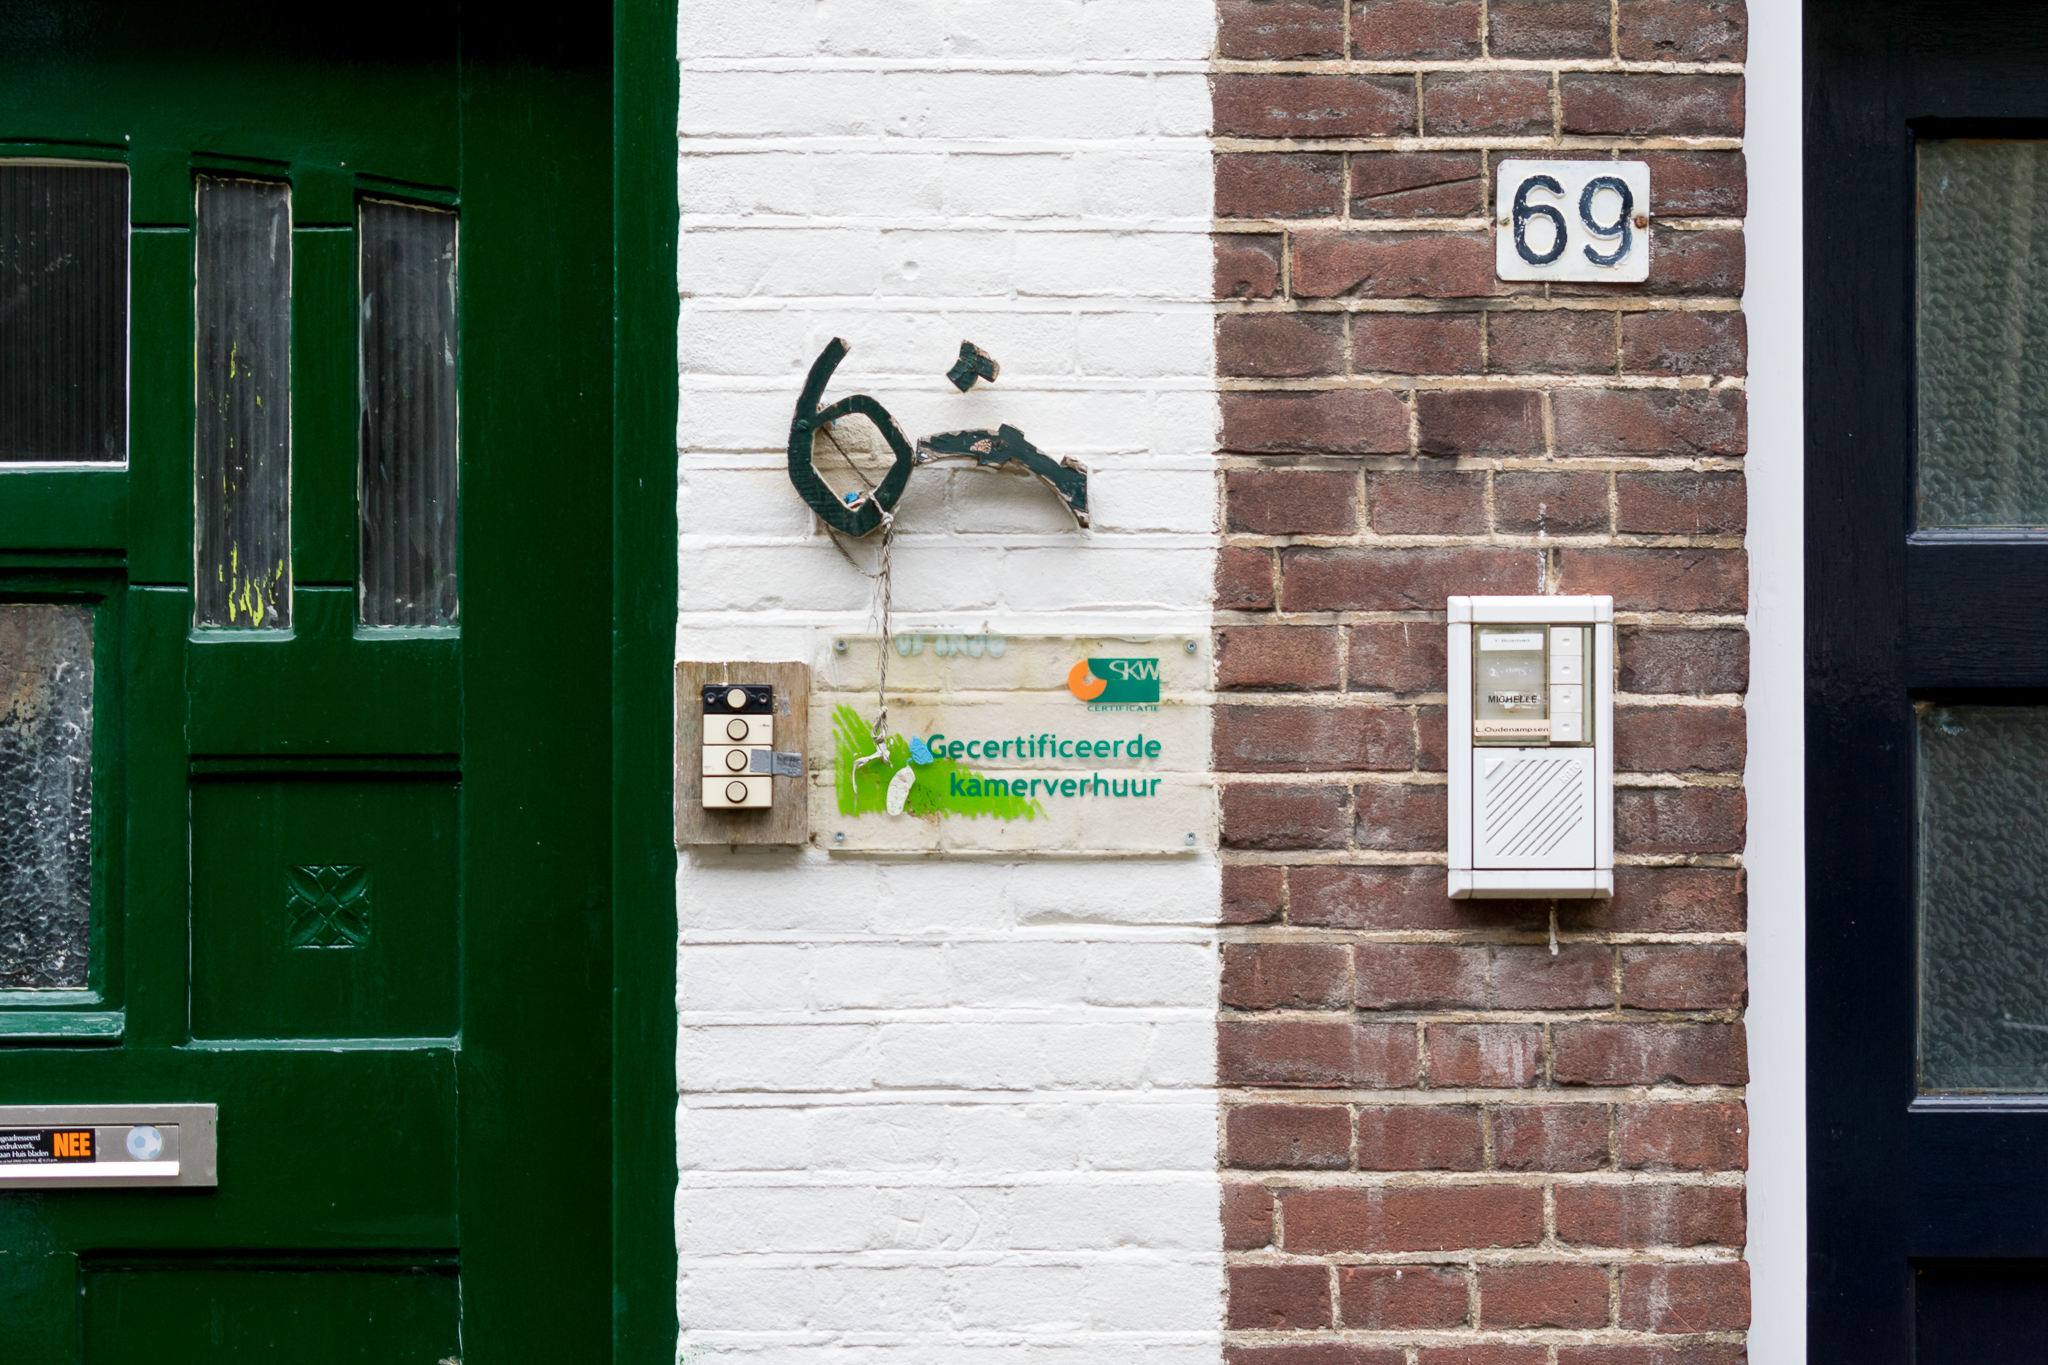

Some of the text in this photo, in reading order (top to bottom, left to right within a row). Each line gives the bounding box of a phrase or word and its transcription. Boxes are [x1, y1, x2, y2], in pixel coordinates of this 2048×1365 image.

[1512, 174, 1634, 268] 69
[1108, 660, 1160, 681] SKW
[1488, 695, 1538, 704] MICHELLE
[926, 733, 1162, 759] Gecertificeerde
[950, 772, 1162, 797] kamerverhuur
[12, 1150, 26, 1158] Huis
[27, 1149, 49, 1157] bladen
[53, 1132, 91, 1157] NEE
